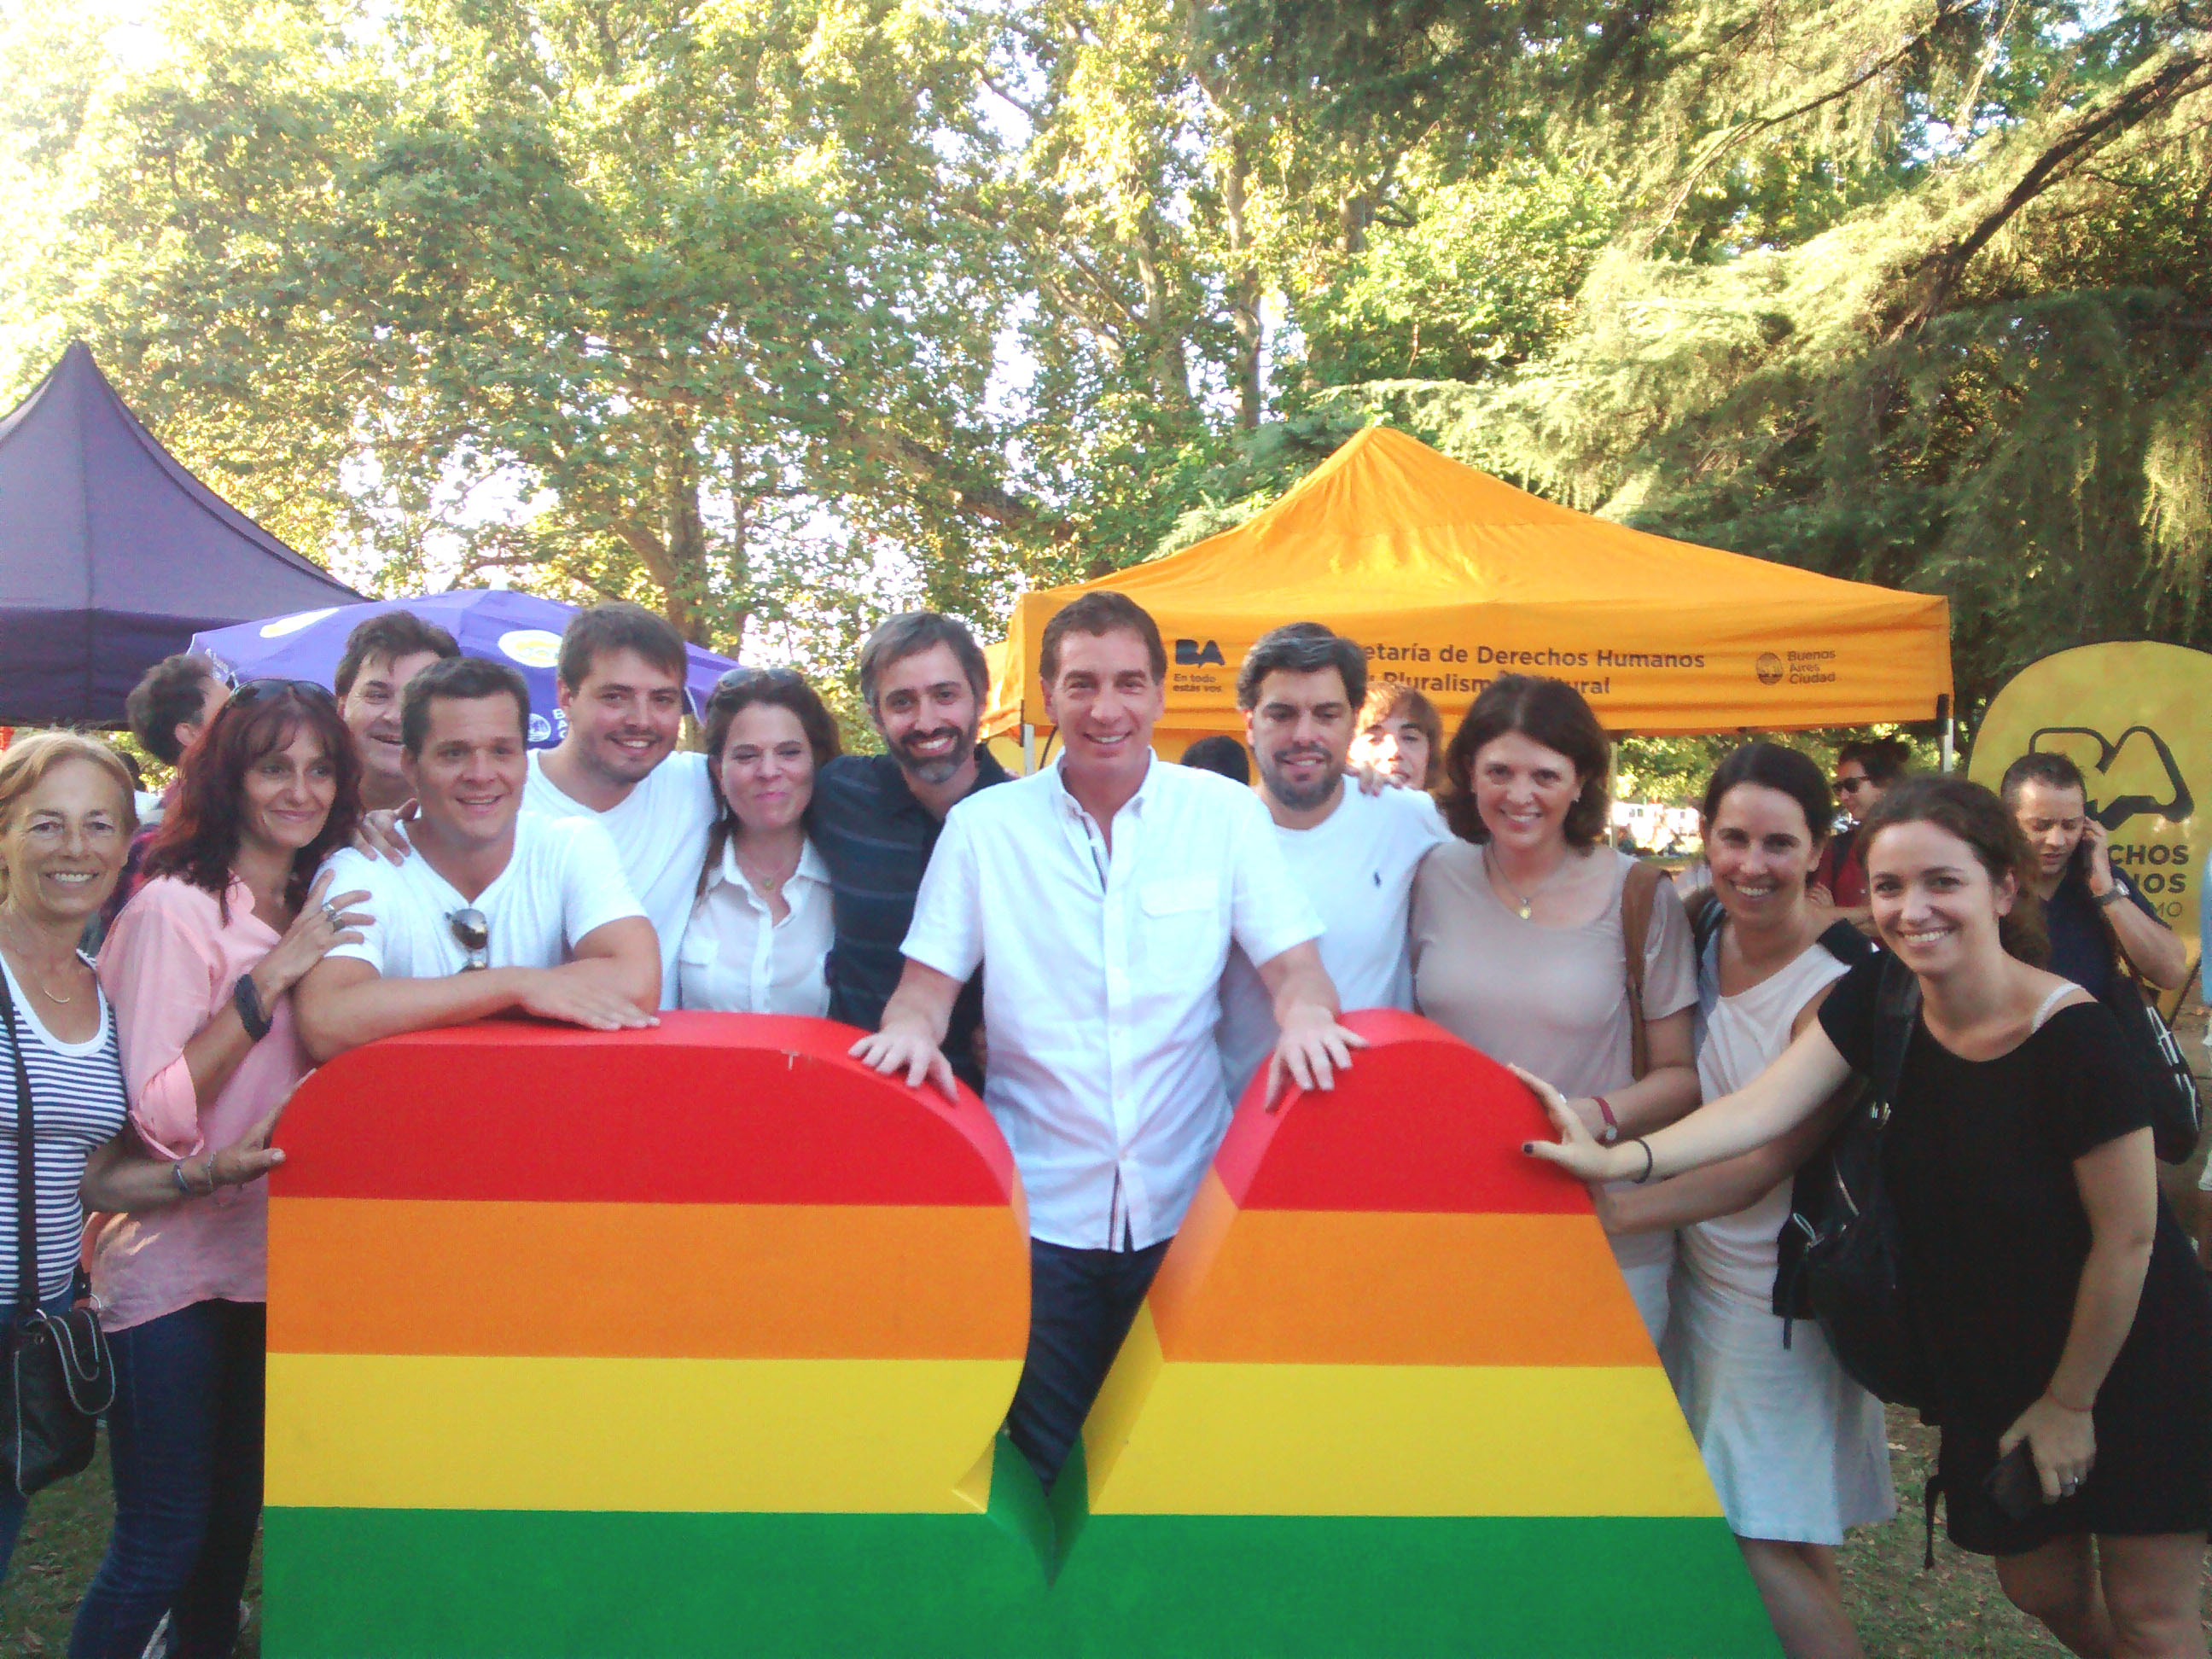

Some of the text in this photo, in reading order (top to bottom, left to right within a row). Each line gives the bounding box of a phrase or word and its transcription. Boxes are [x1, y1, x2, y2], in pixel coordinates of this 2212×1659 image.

[1439, 644, 1468, 663] de
[1477, 646, 1588, 667] Derechos
[1598, 649, 1705, 667] Humanos
[1788, 650, 1837, 661] Buenos
[1790, 663, 1820, 672] Aires
[1790, 672, 1836, 684] Ciudad
[2107, 844, 2189, 865] CHOS
